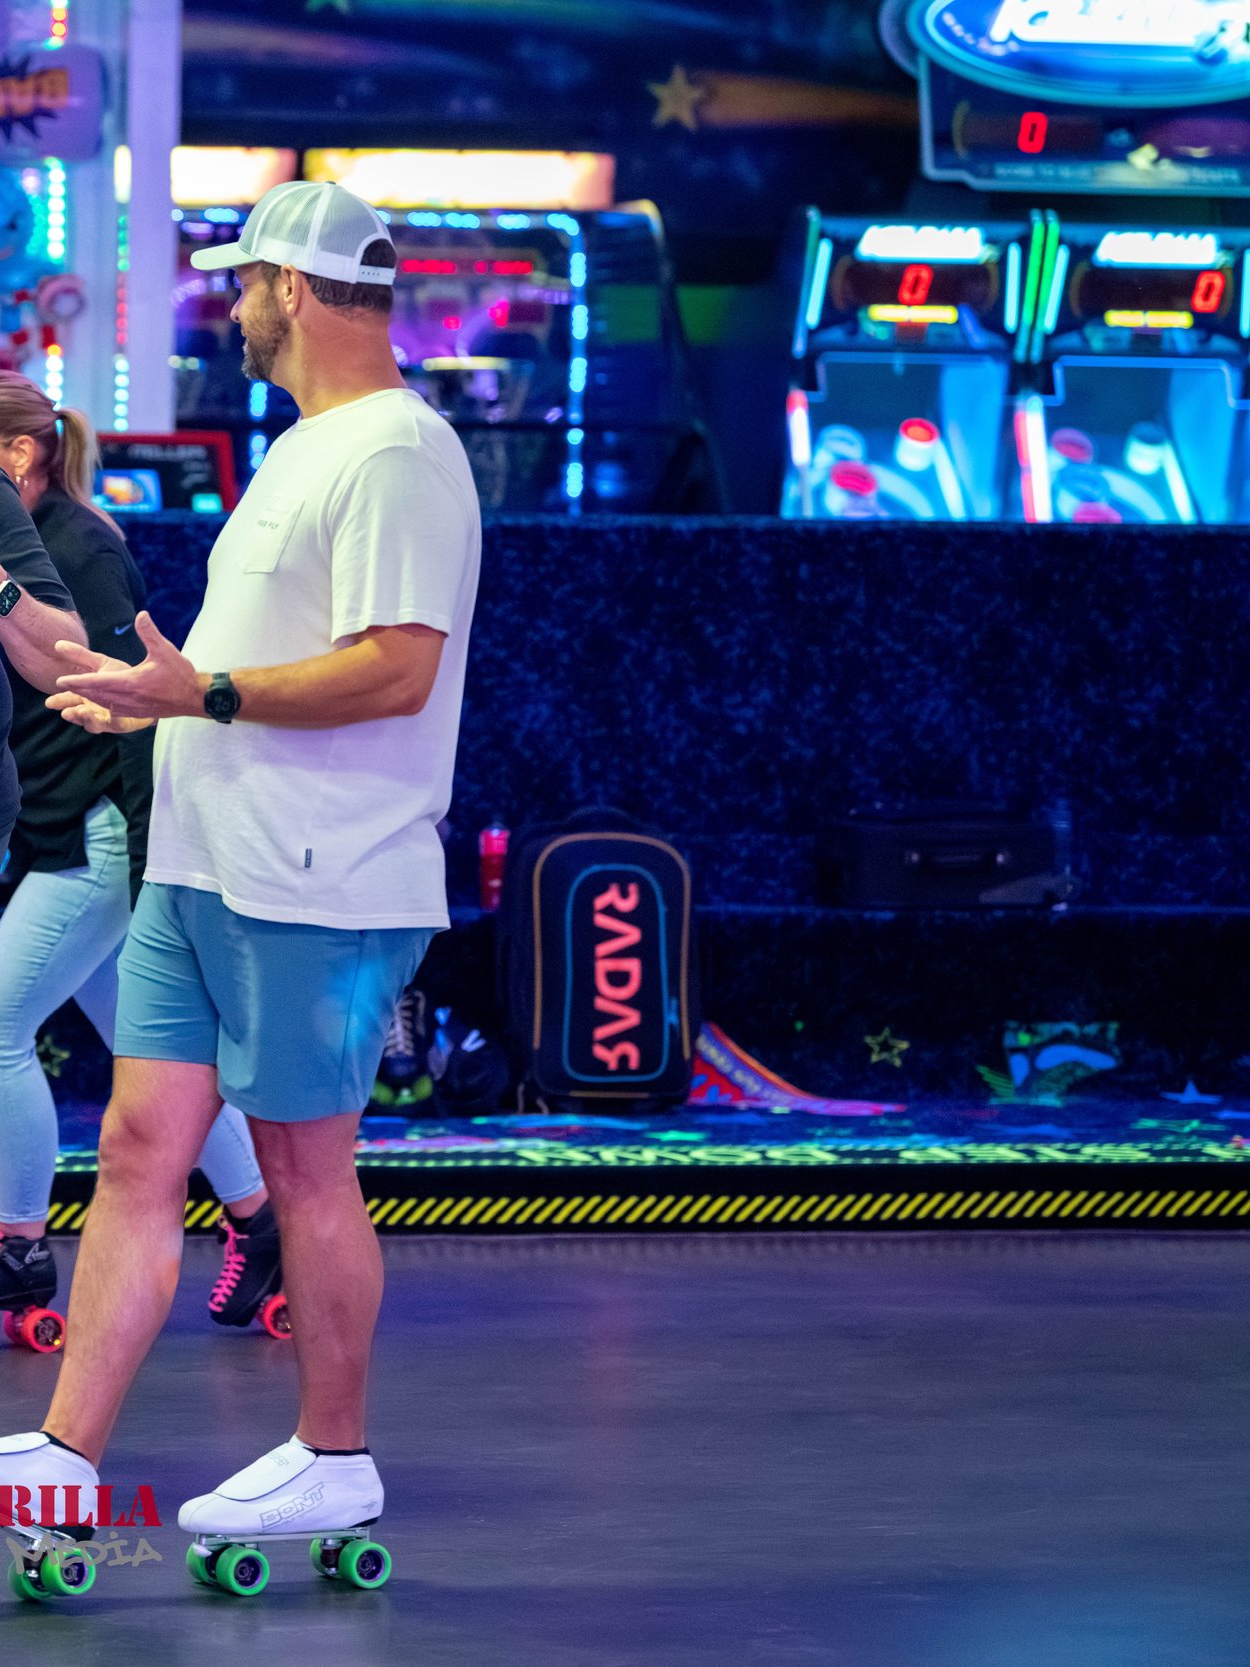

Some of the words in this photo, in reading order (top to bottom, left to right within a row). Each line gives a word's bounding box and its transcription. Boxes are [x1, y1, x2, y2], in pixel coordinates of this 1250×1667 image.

[1017, 112, 1048, 153] 0
[898, 264, 934, 305] 0
[1191, 271, 1226, 313] 0
[592, 882, 642, 1071] RADAR
[898, 1146, 1151, 1161] STEP
[259, 1481, 325, 1529] BONT
